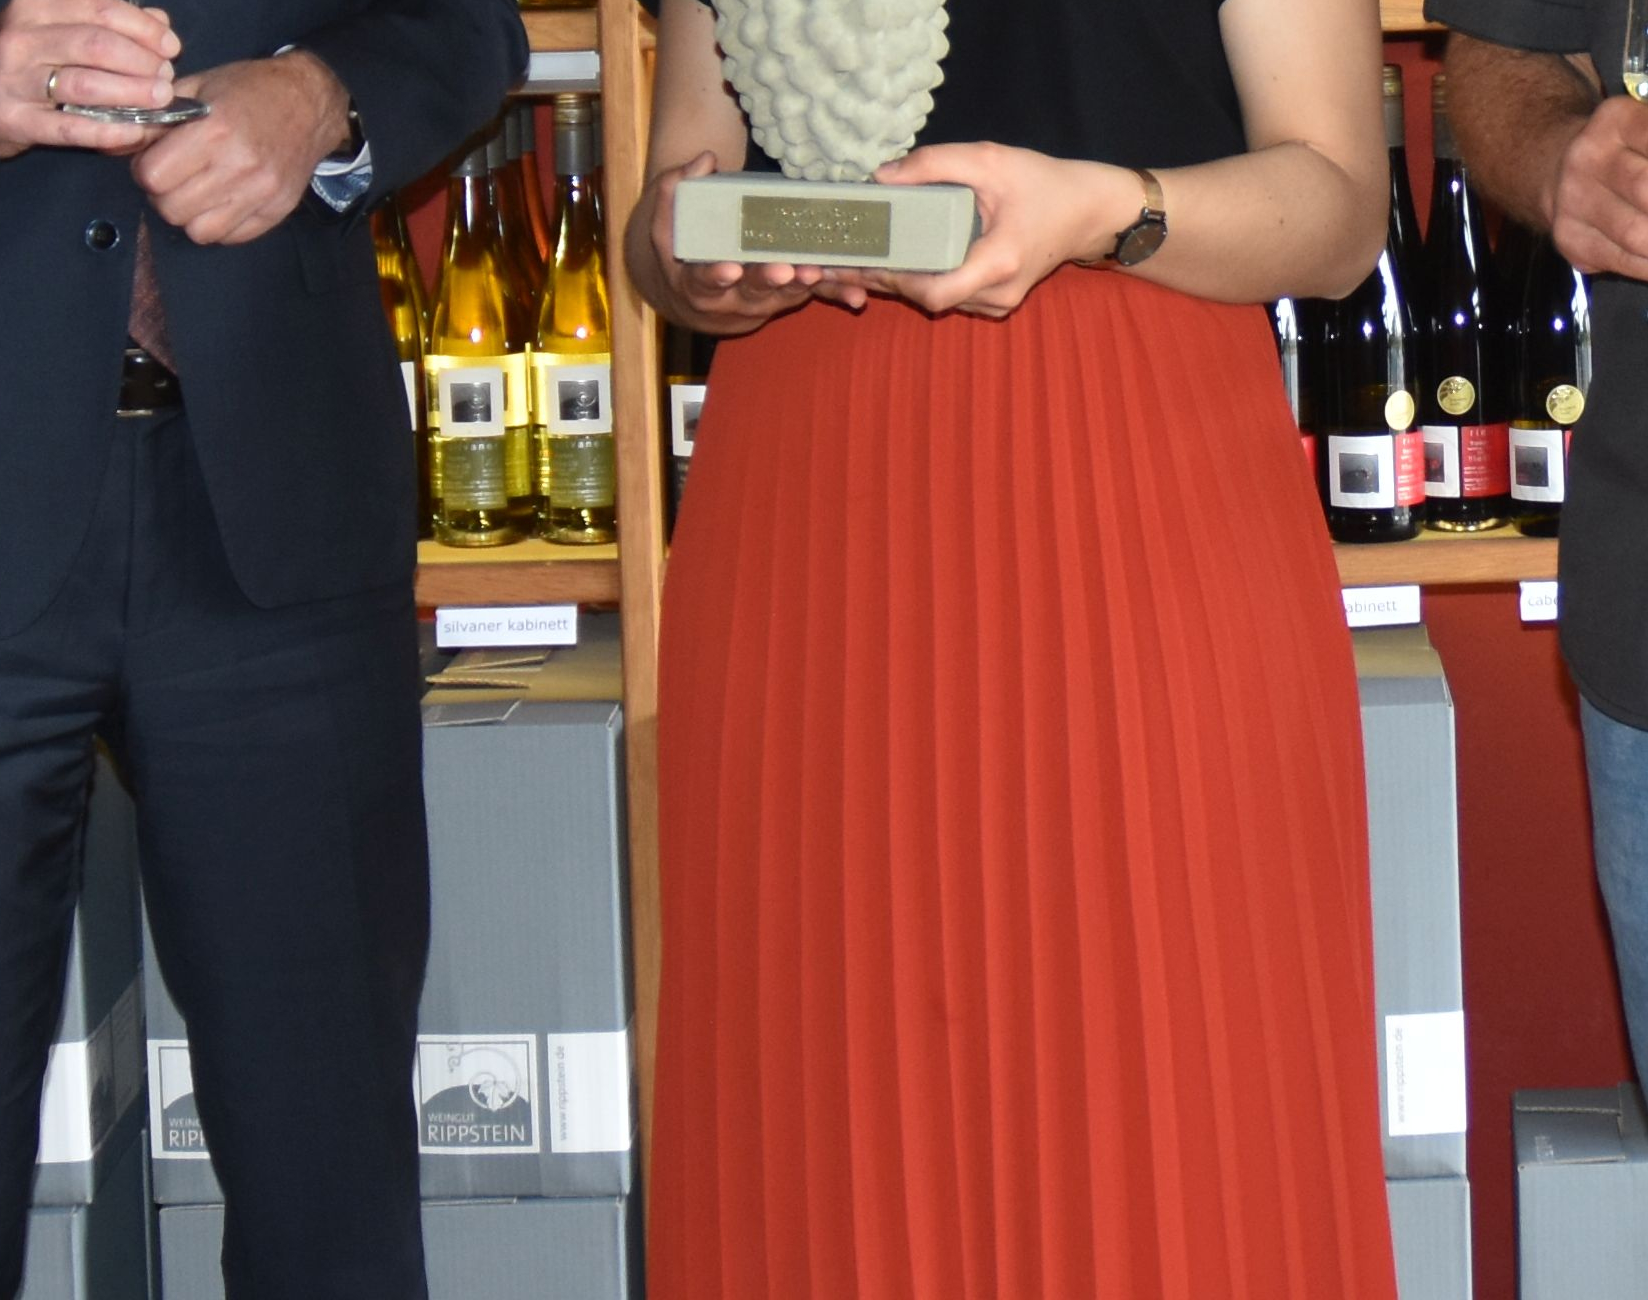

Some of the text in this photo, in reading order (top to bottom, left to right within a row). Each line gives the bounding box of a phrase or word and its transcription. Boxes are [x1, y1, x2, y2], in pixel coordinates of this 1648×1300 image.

[1345, 600, 1398, 613] abinett
[444, 619, 569, 633] silvaner kabinett
[428, 1113, 475, 1122] WEINGUT
[427, 1124, 525, 1142] RIPPSTEIN
